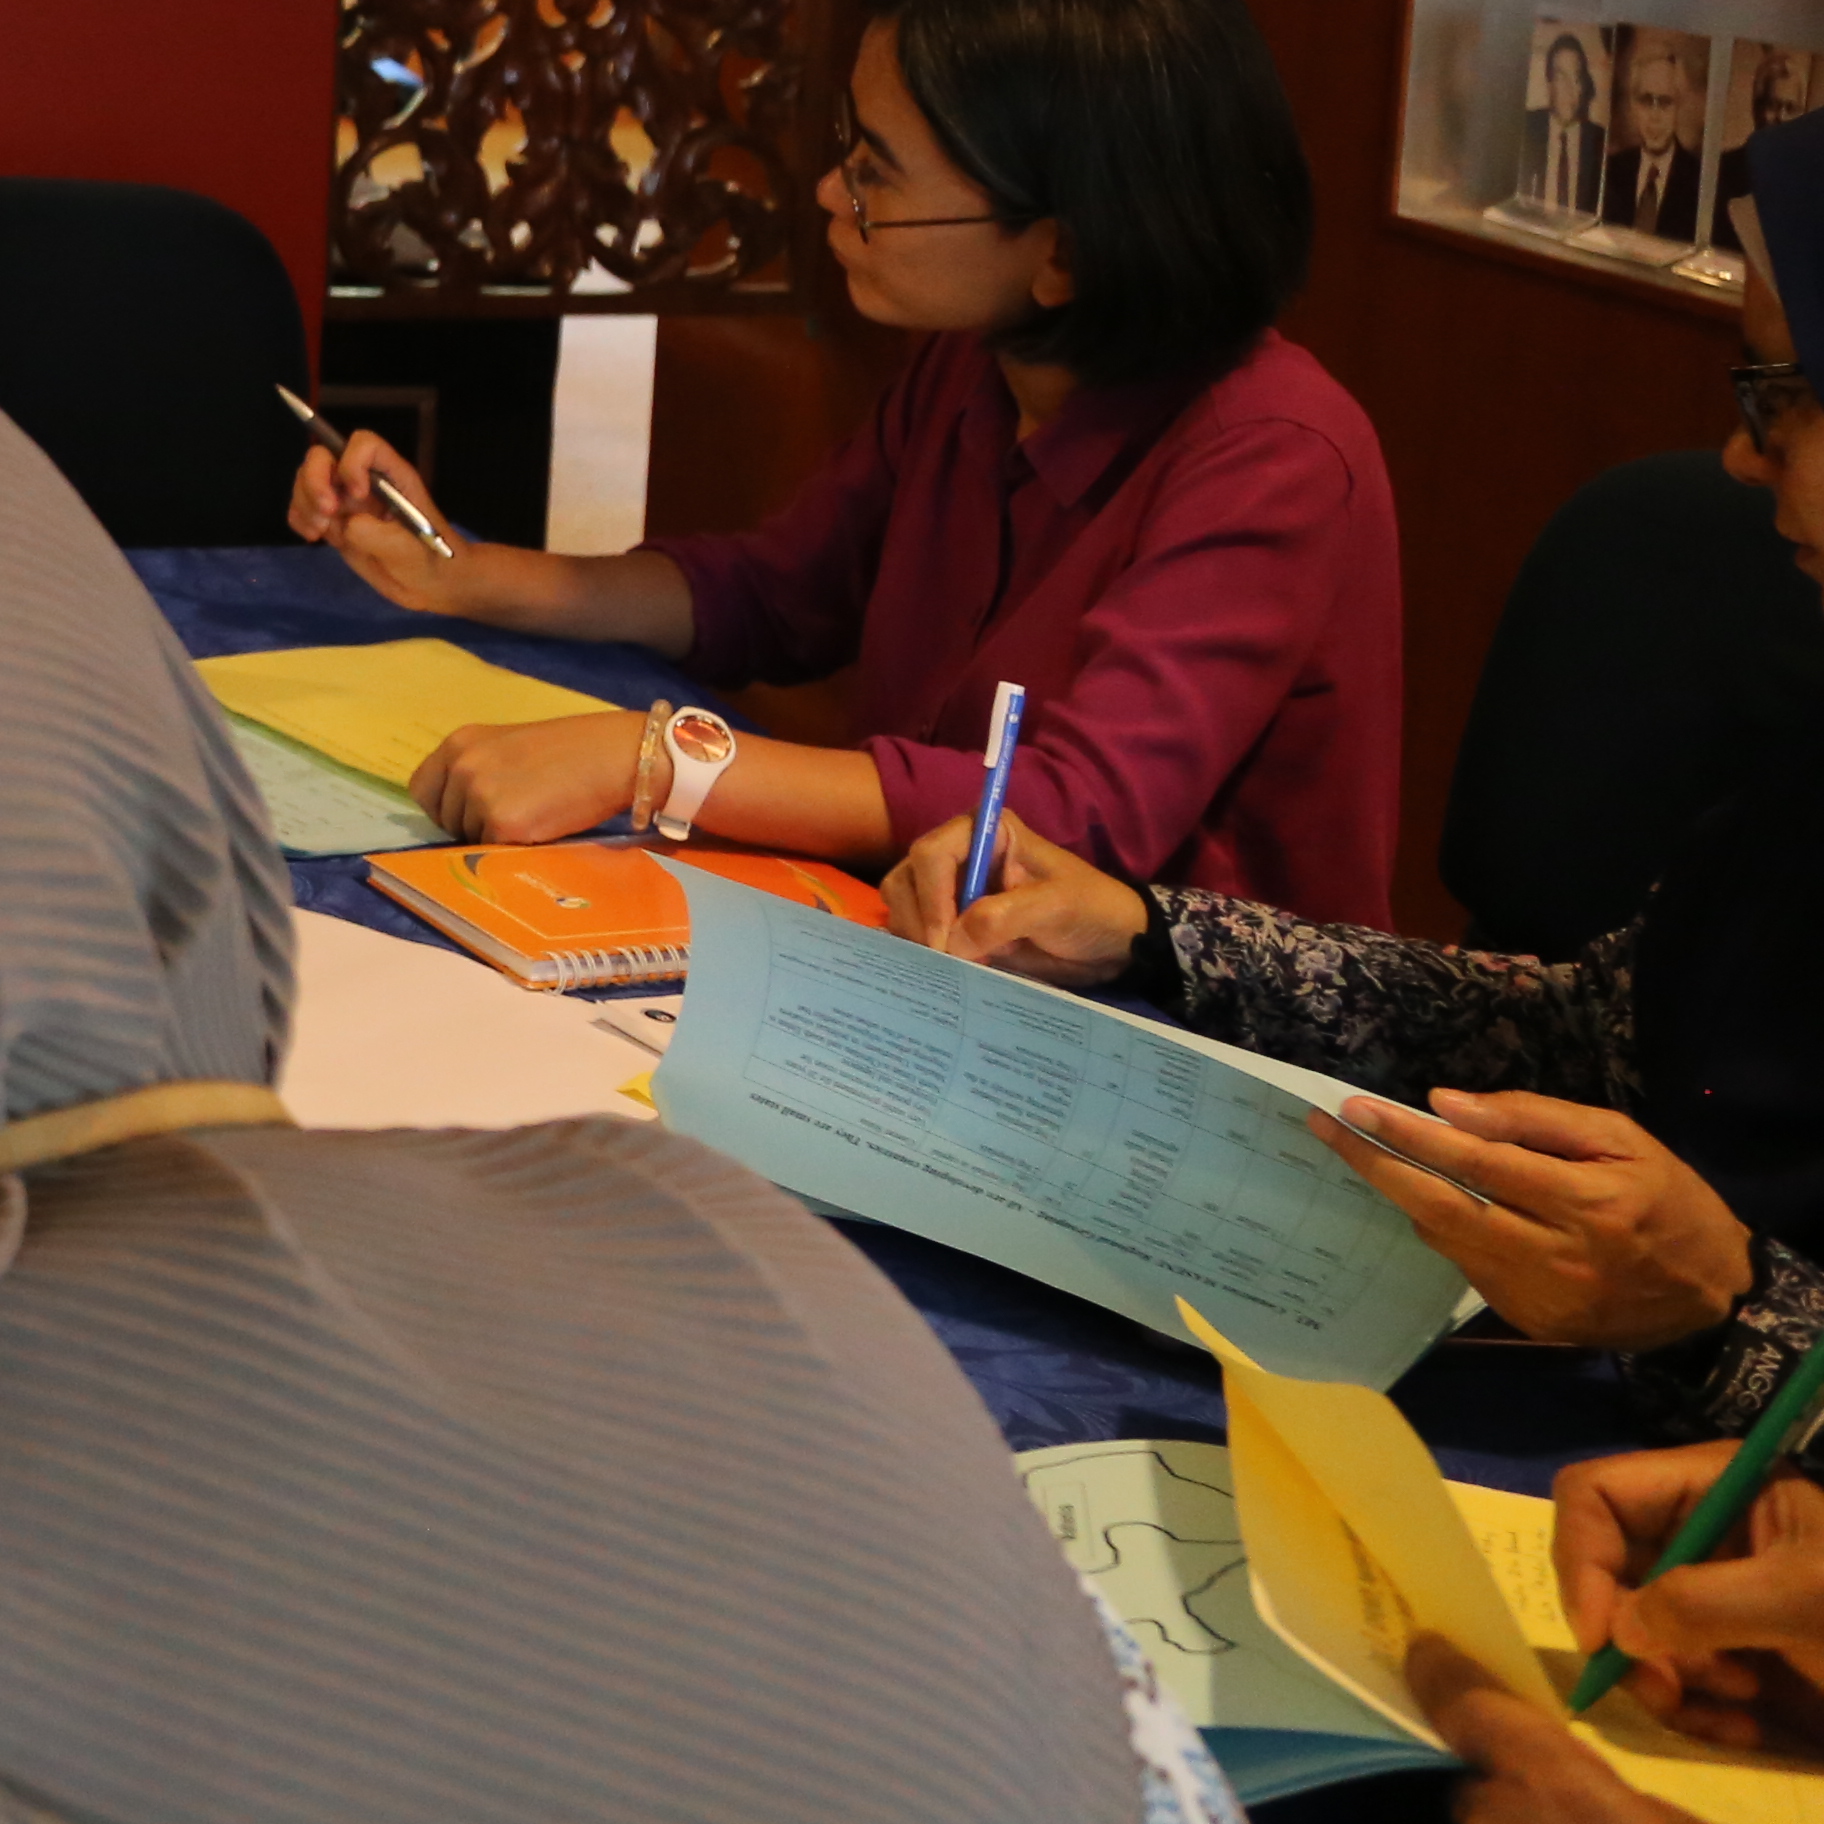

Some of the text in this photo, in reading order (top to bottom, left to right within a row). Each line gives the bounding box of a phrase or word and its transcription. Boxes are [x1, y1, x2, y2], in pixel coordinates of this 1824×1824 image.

[748, 1092, 779, 1111] states
[780, 1105, 811, 1124] small
[813, 1119, 832, 1132] are
[833, 1126, 861, 1147] They
